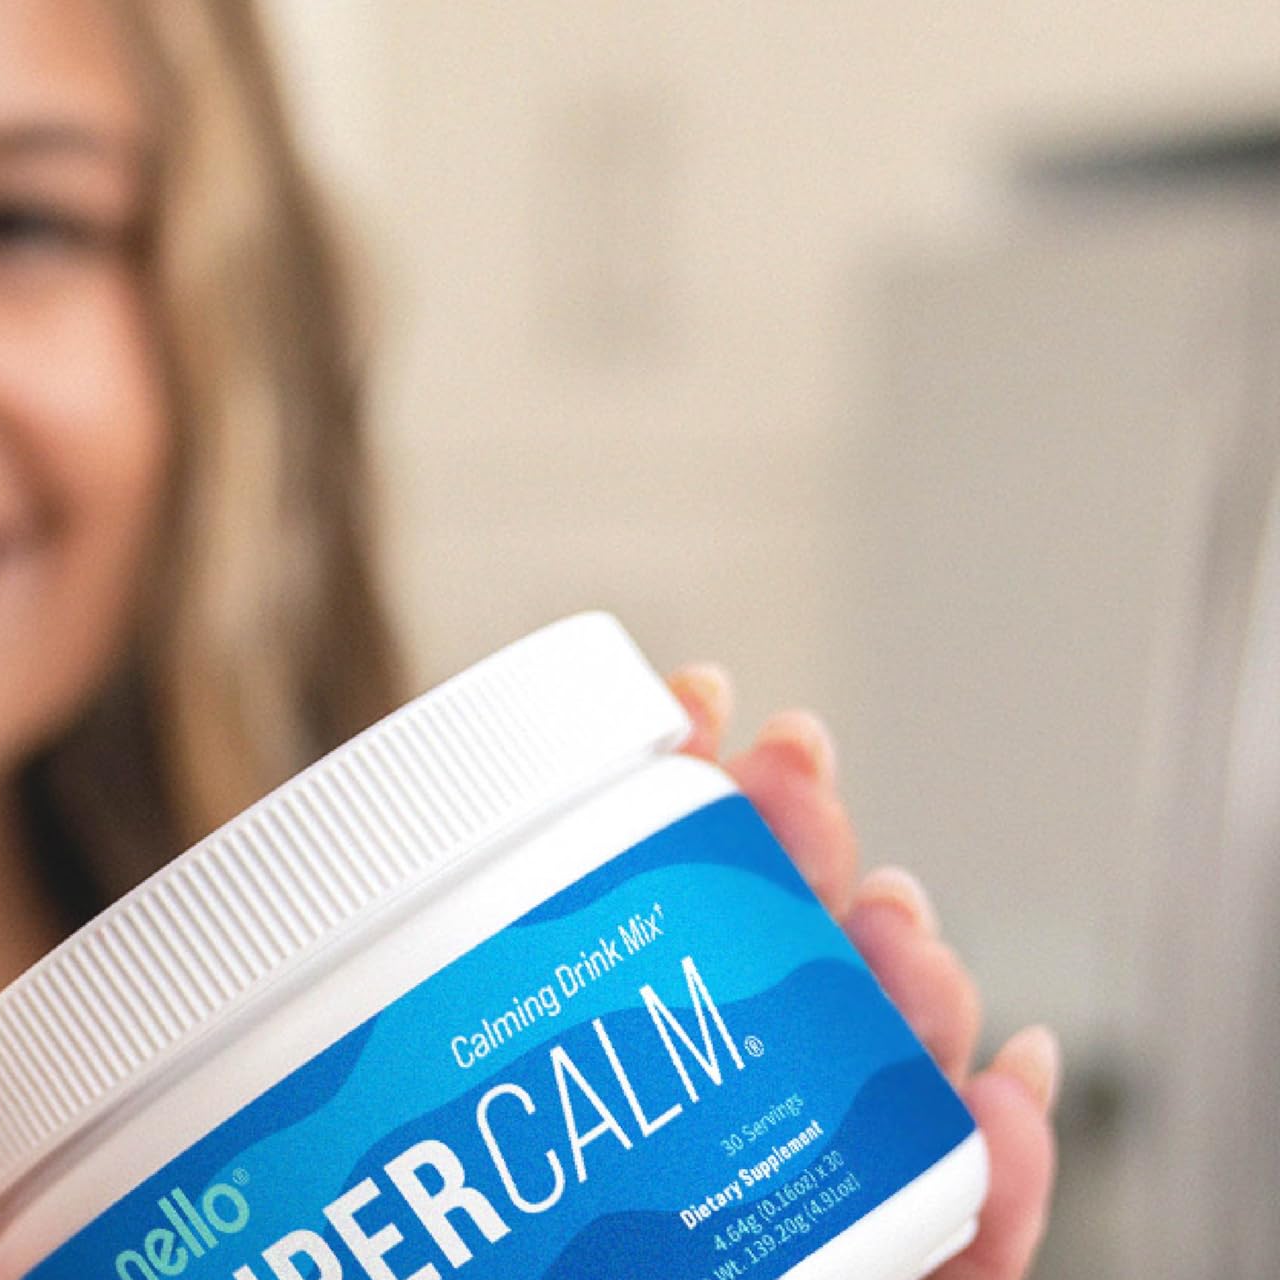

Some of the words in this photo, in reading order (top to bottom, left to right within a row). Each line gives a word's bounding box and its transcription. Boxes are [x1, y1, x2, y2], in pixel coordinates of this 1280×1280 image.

[451, 985, 561, 1069] Calming
[554, 938, 623, 998] Drink
[721, 1134, 744, 1157] 30
[742, 1093, 804, 1142] Servings
[680, 1181, 742, 1230] Dietary
[738, 1120, 824, 1187] Supplement
[816, 1166, 829, 1179] x
[822, 1150, 845, 1172] 30
[744, 1217, 811, 1265] 139.20g
[805, 1171, 862, 1223] (4.91oz)
[757, 1169, 819, 1222] (0.16oz)
[714, 1213, 763, 1251] 4.64g
